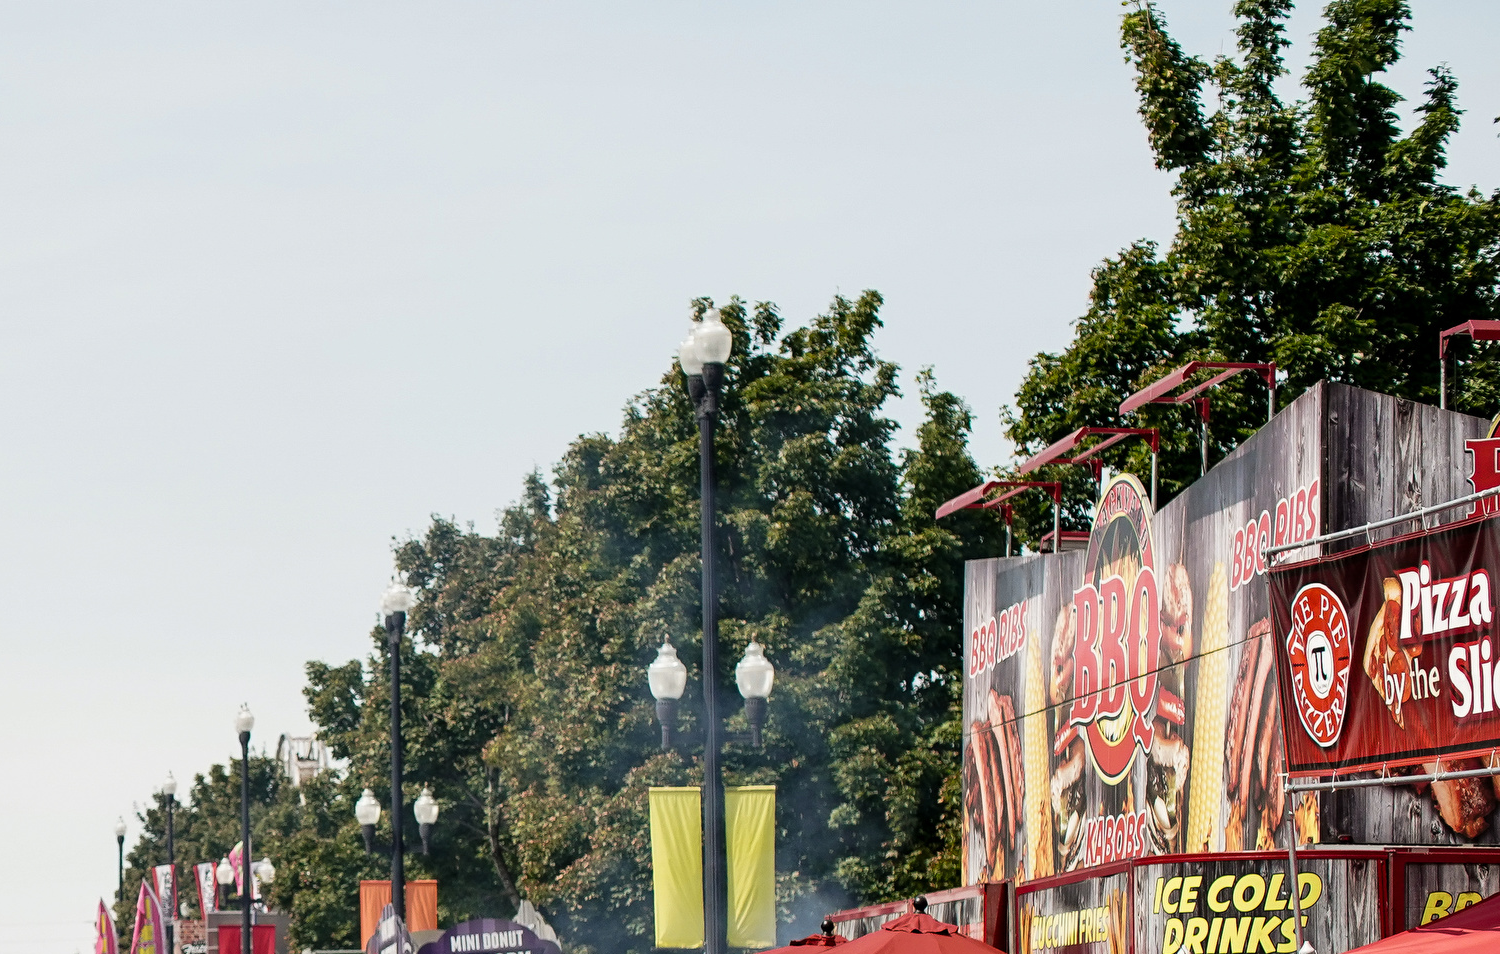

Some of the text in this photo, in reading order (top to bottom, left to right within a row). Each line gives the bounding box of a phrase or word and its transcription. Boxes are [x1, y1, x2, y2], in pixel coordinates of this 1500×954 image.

[1230, 476, 1319, 592] BBQ RIBS
[1290, 594, 1347, 657] THE PIE
[1399, 563, 1493, 641] Pizza
[969, 600, 1030, 679] BBQ RIBS
[1070, 566, 1161, 757] BBQ
[1294, 665, 1349, 738] PIZZERIA
[1383, 662, 1406, 714] by
[1409, 657, 1441, 699] the
[1083, 808, 1147, 868] KABOBS
[1153, 872, 1322, 914] ICE COLD
[451, 930, 523, 952] MINI DONUT
[1031, 906, 1110, 951] ZUCCHINI FRIES
